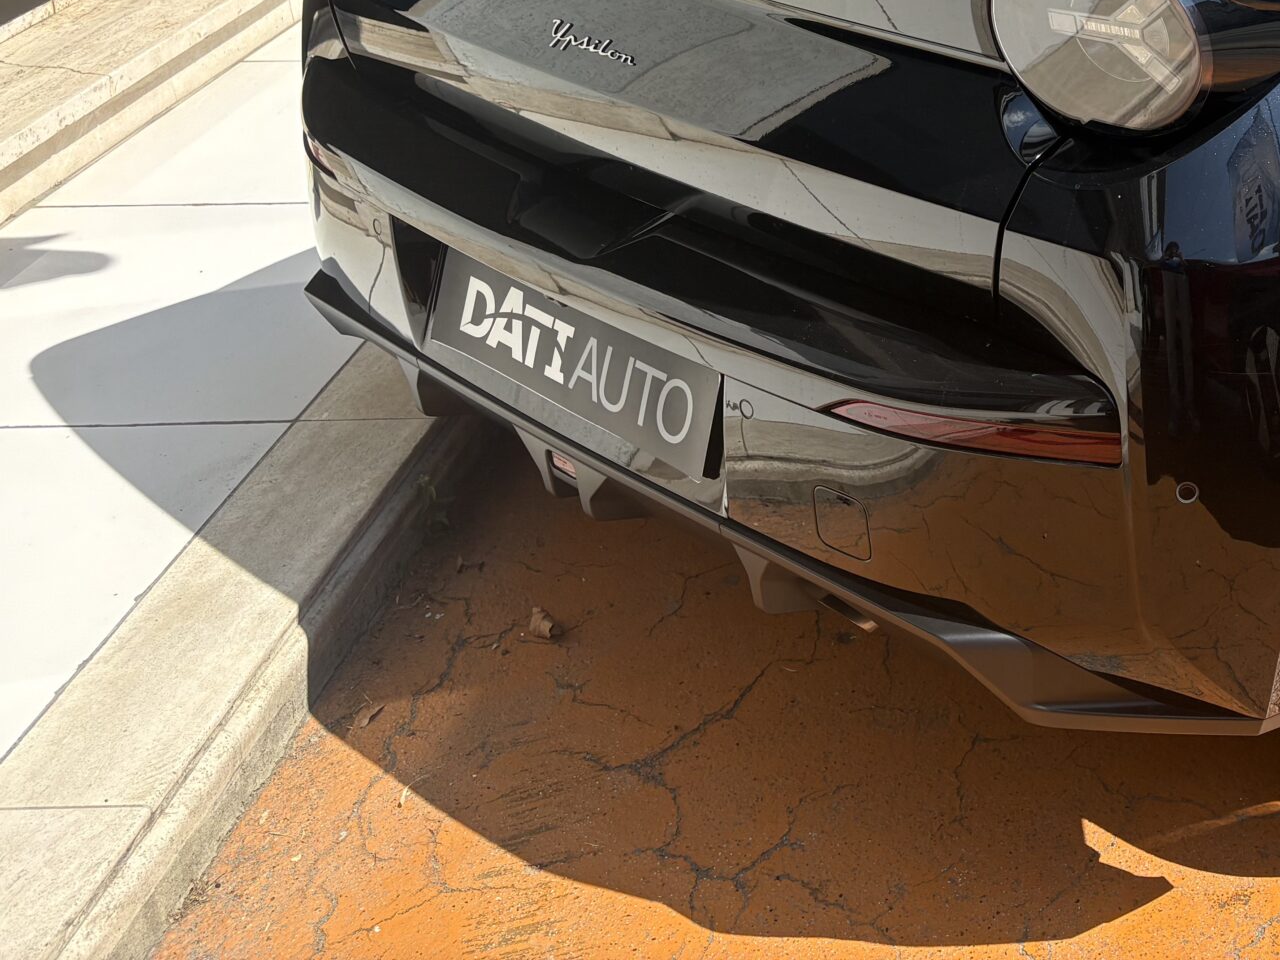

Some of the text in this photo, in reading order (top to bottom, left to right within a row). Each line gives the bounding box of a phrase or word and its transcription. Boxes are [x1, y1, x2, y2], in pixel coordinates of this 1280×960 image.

[548, 18, 638, 67] Ypsilon
[459, 275, 694, 445] DATI AUTO
